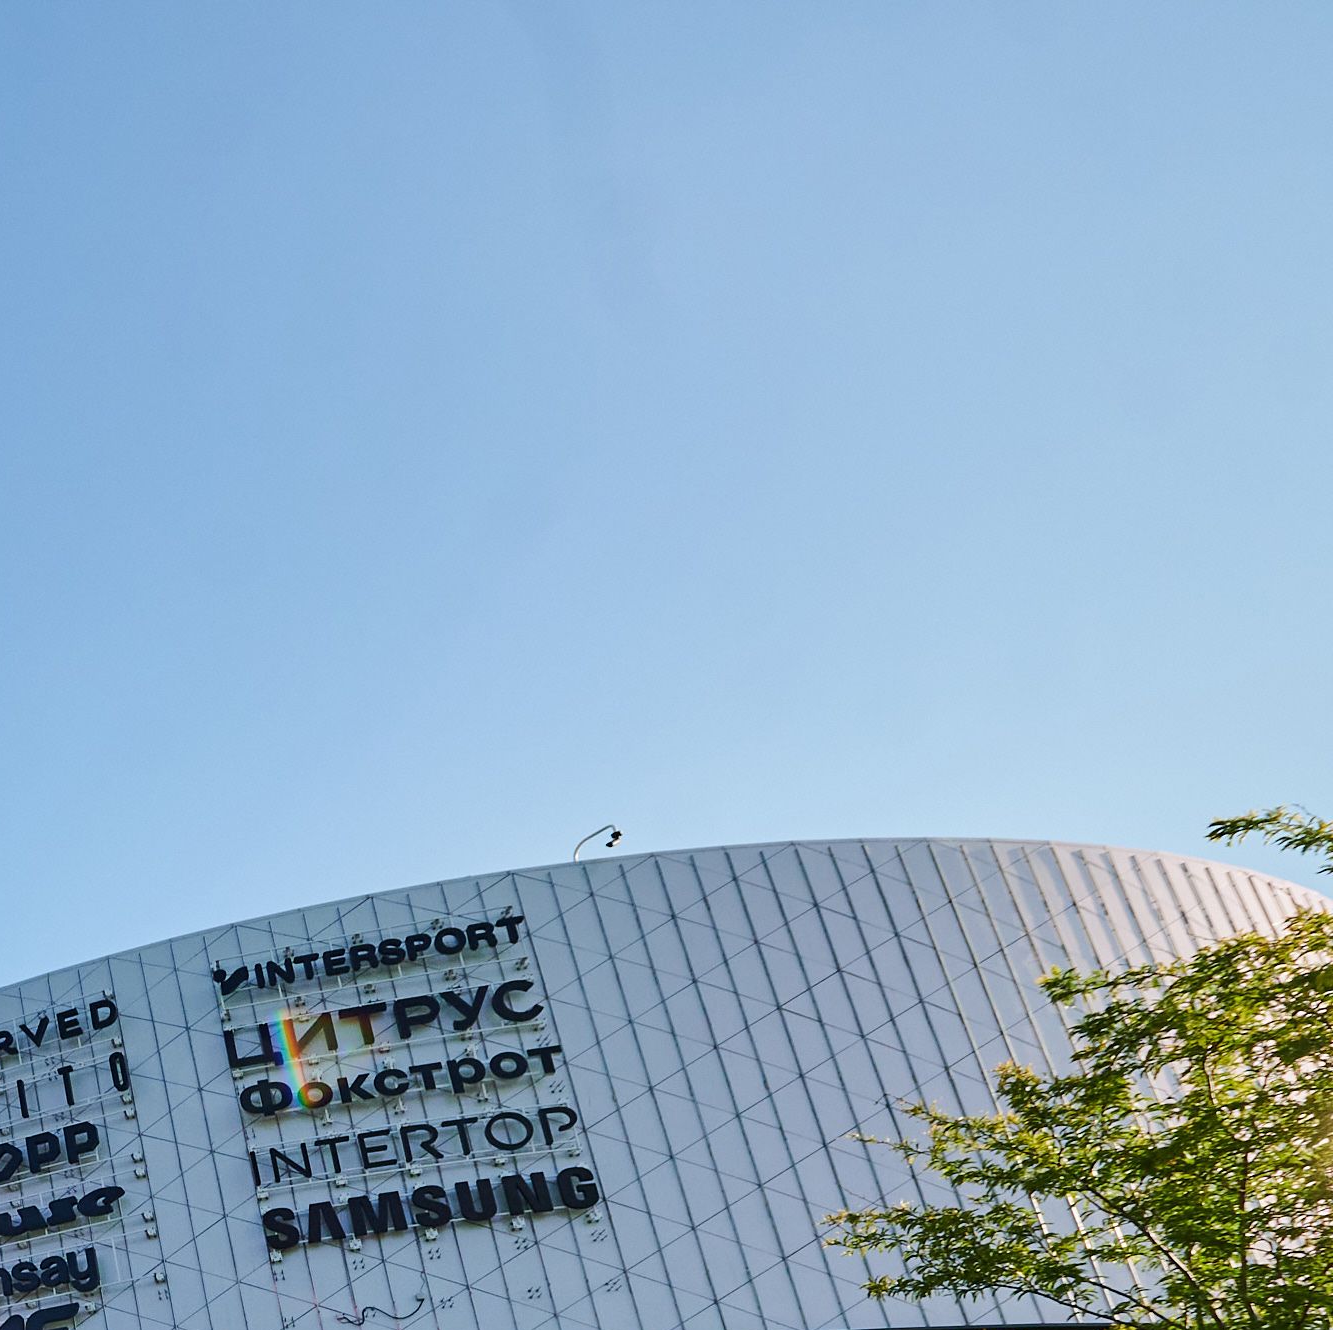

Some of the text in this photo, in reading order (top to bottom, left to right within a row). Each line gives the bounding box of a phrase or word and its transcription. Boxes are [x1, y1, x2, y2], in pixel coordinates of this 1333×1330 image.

[253, 914, 525, 990] INTERSPORT
[223, 979, 545, 1070] ЦИТРУС
[239, 1044, 563, 1117] Фокстрот
[249, 1106, 579, 1186] INTERTOP
[262, 1166, 600, 1250] SAMSUNG
